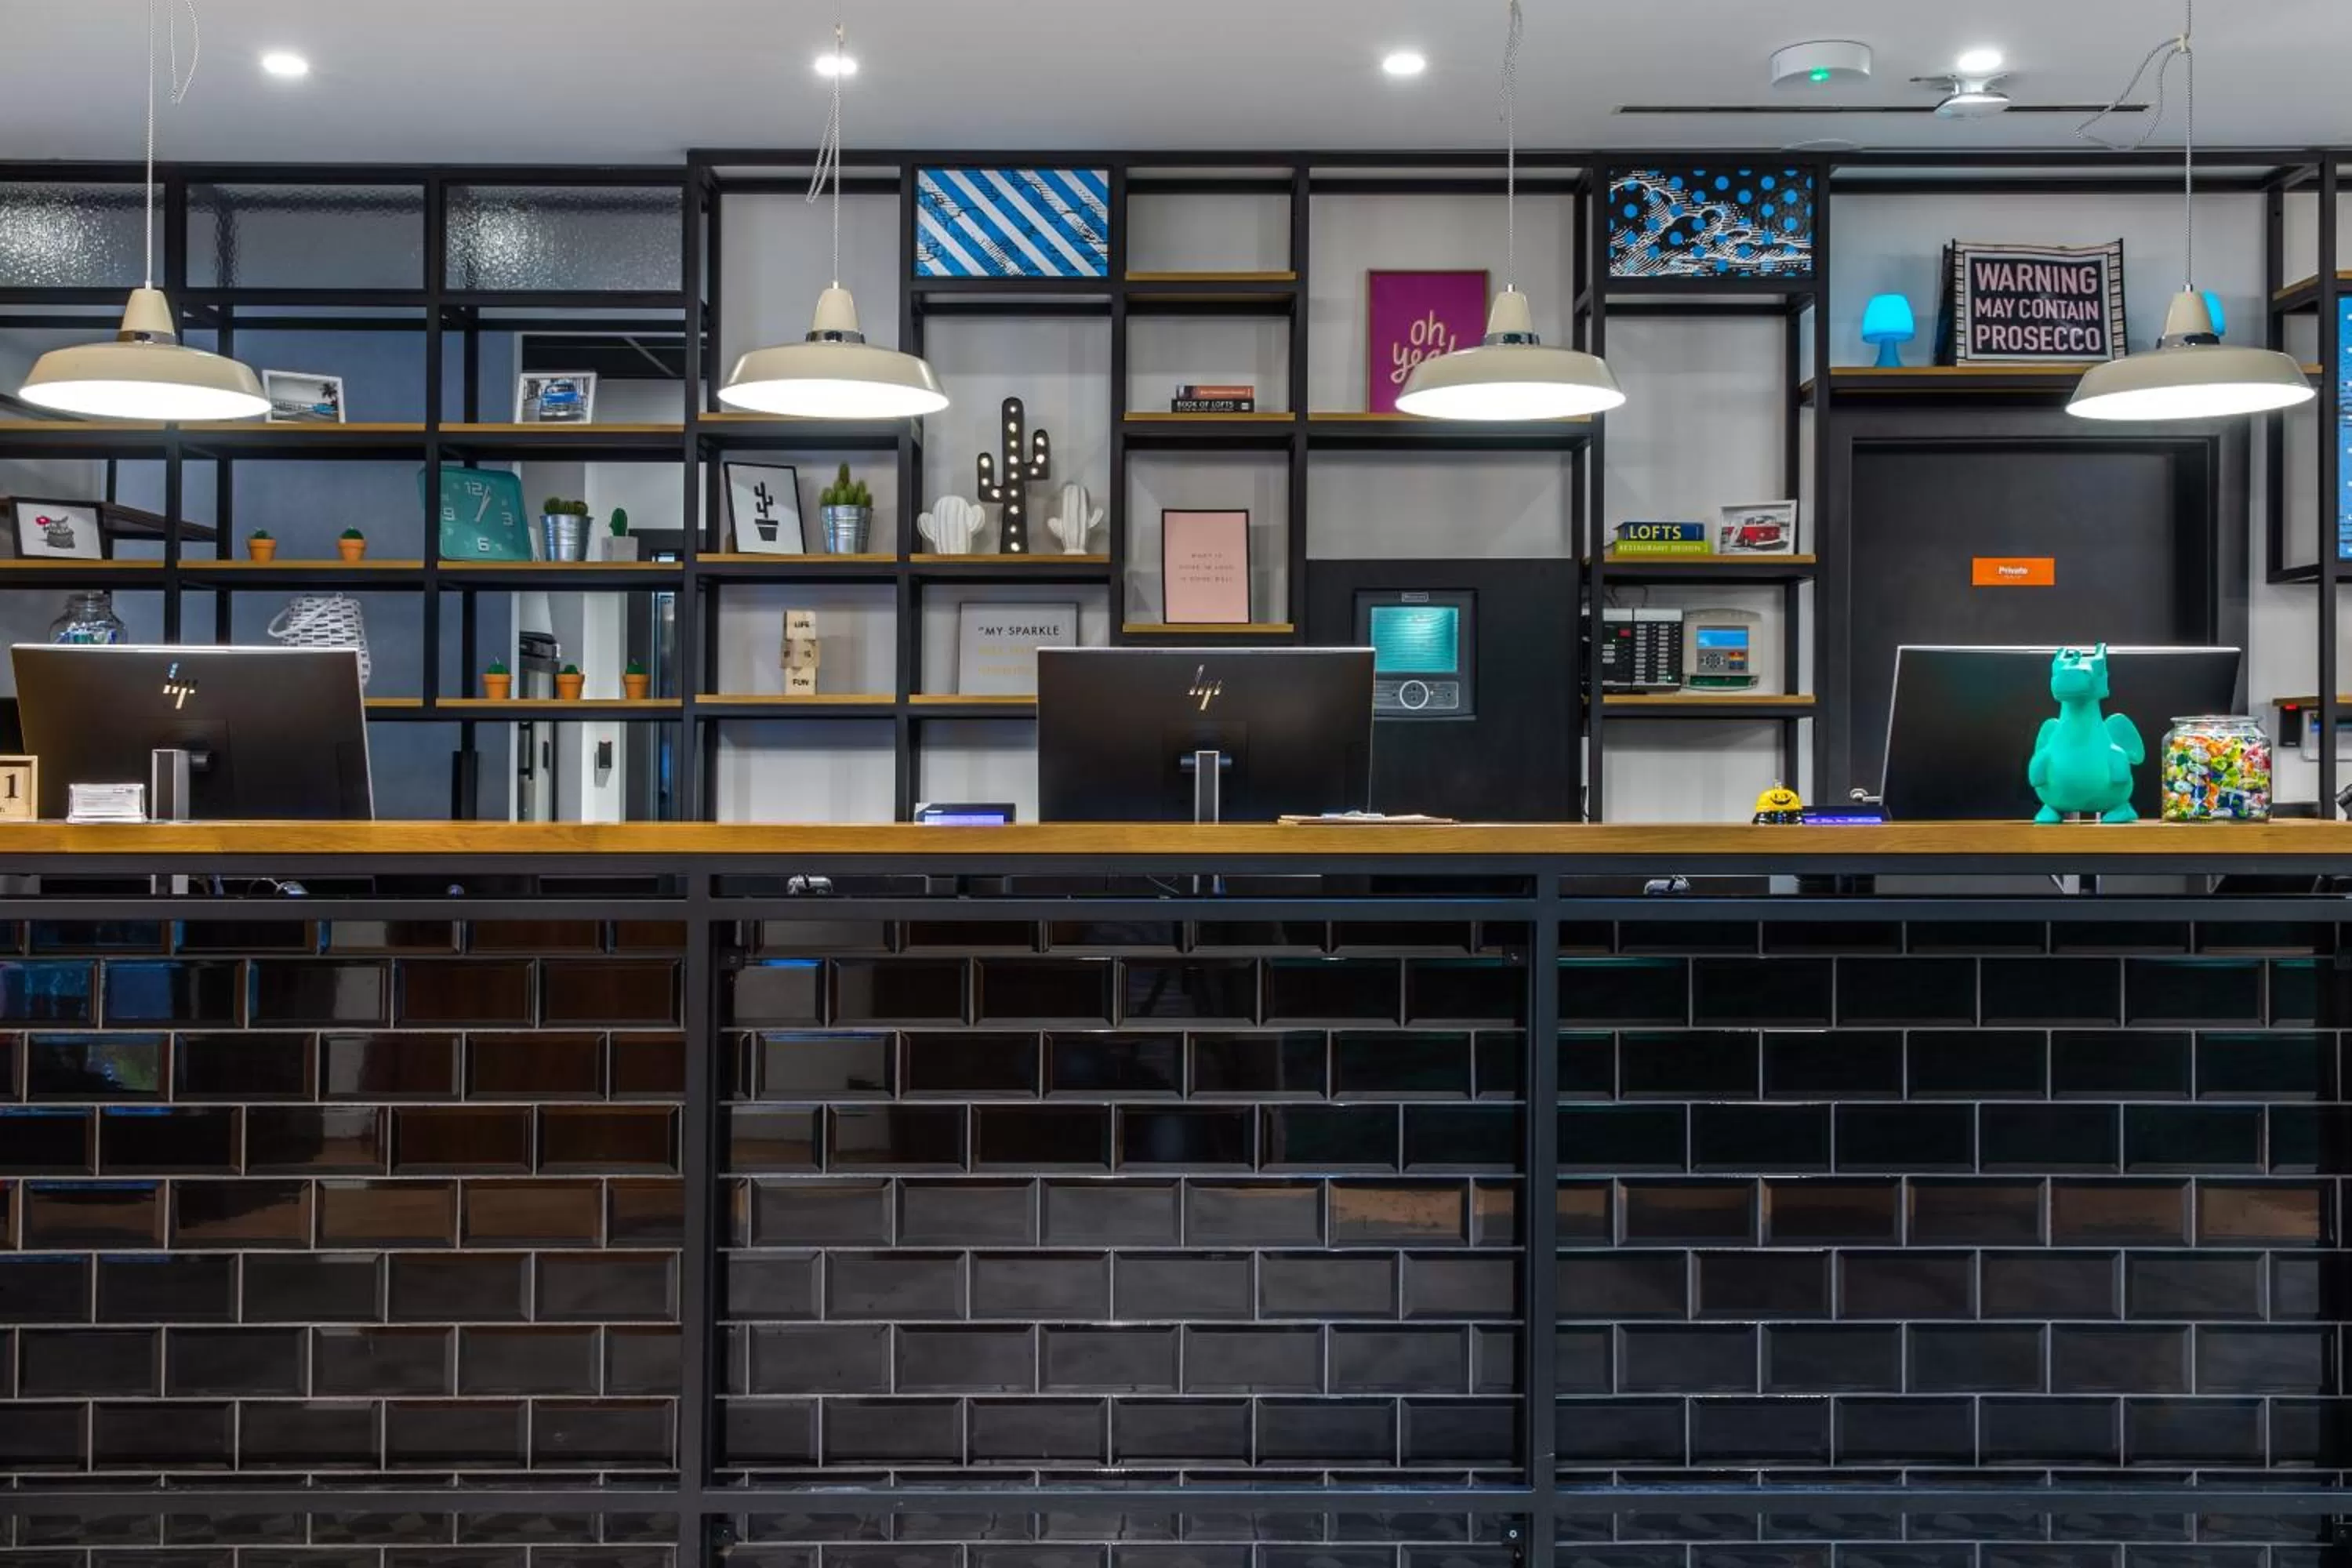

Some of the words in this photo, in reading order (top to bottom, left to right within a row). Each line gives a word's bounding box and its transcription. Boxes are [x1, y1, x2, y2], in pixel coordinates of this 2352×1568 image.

[1975, 263, 2098, 295] WARNING
[1975, 297, 2016, 318] MAY
[2019, 299, 2099, 321] CONTAIN
[1410, 309, 1446, 347] oh
[1976, 325, 2101, 351] PROSECCO
[464, 481, 484, 496] 12
[443, 507, 456, 521] 9
[502, 511, 514, 526] 3
[1629, 524, 1682, 540] LOFTS
[477, 536, 490, 552] 6
[1998, 565, 2028, 575] Private
[1009, 626, 1060, 636] SPARKLE
[5, 773, 20, 799] 1
